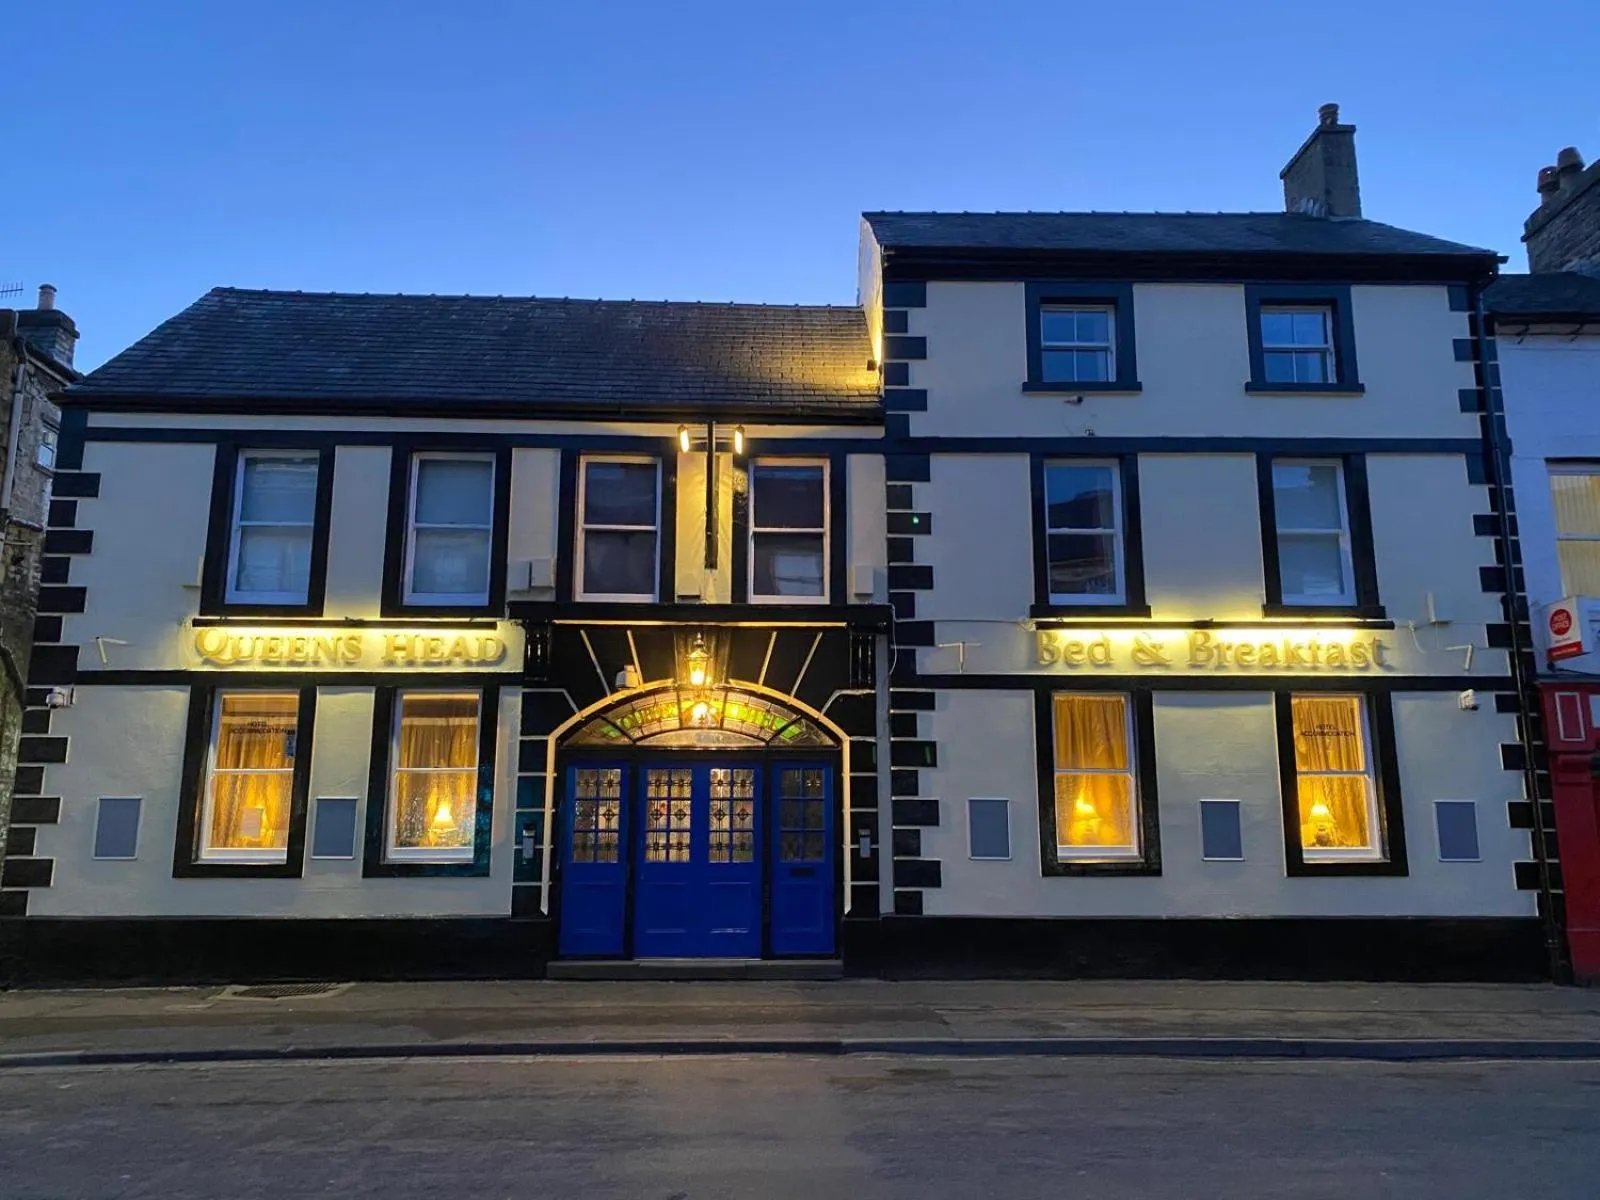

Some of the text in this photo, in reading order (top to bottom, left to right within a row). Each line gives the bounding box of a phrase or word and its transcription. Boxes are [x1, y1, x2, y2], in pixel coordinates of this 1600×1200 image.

[195, 629, 505, 666] QUEENS HEAD
[1035, 629, 1386, 667] Bed & Breakfast
